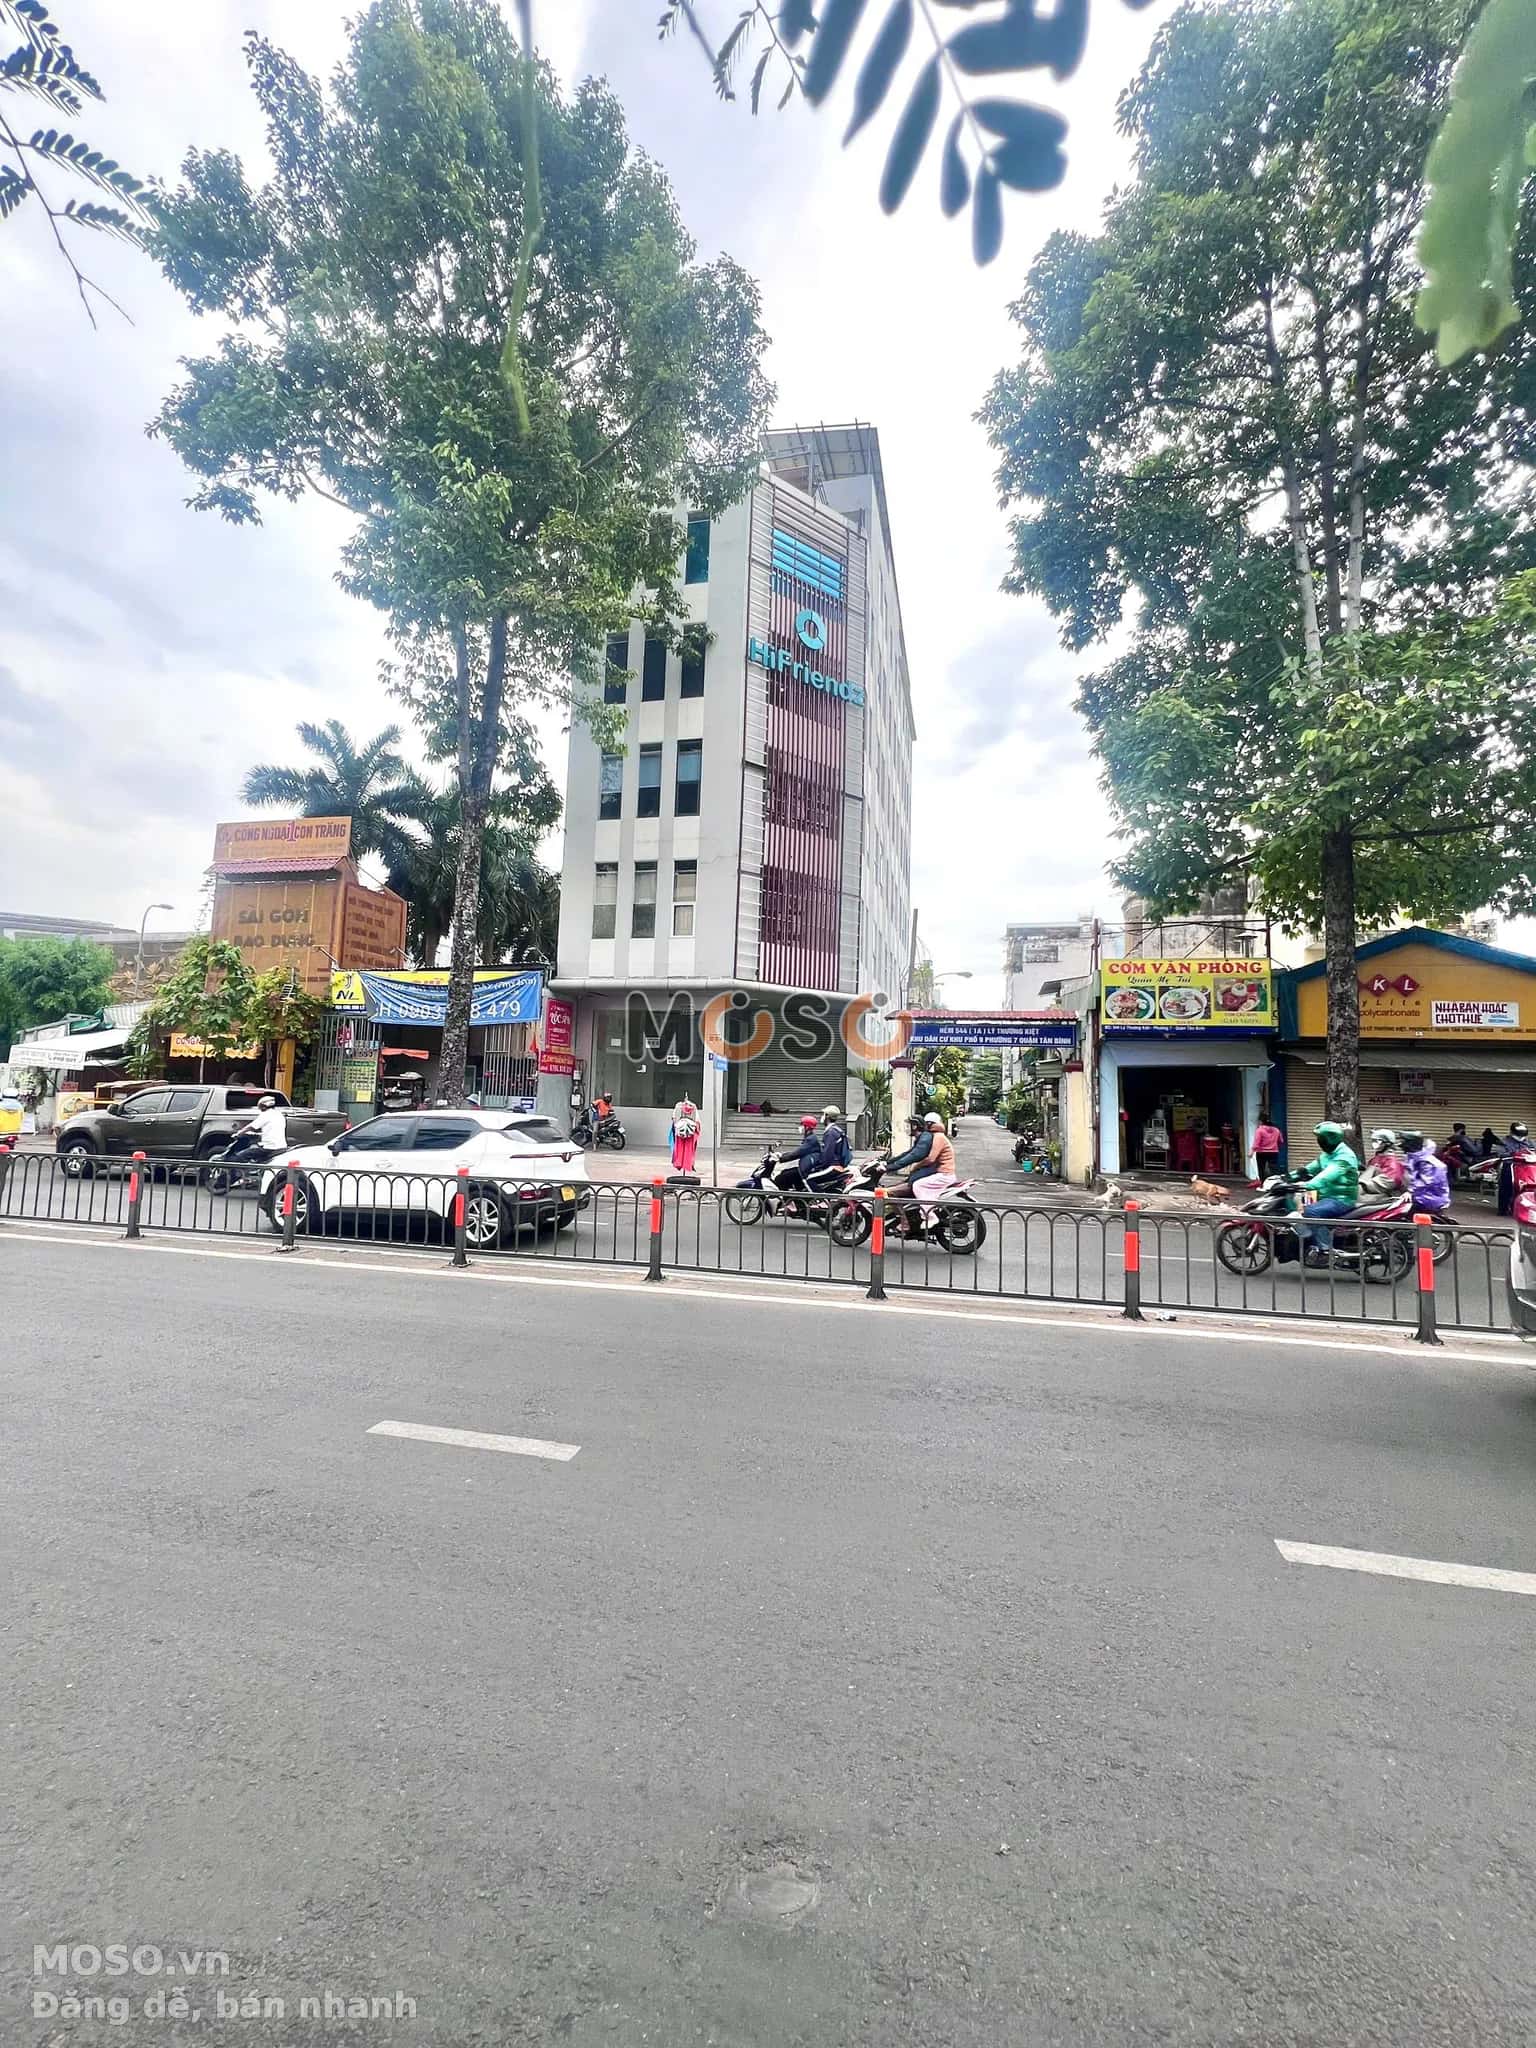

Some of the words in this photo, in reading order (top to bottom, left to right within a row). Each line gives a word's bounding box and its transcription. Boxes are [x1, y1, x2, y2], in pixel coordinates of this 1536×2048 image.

[1108, 961, 1146, 974] CƠM
[1151, 960, 1191, 974] VĂN
[1197, 960, 1263, 974] PHÒNG
